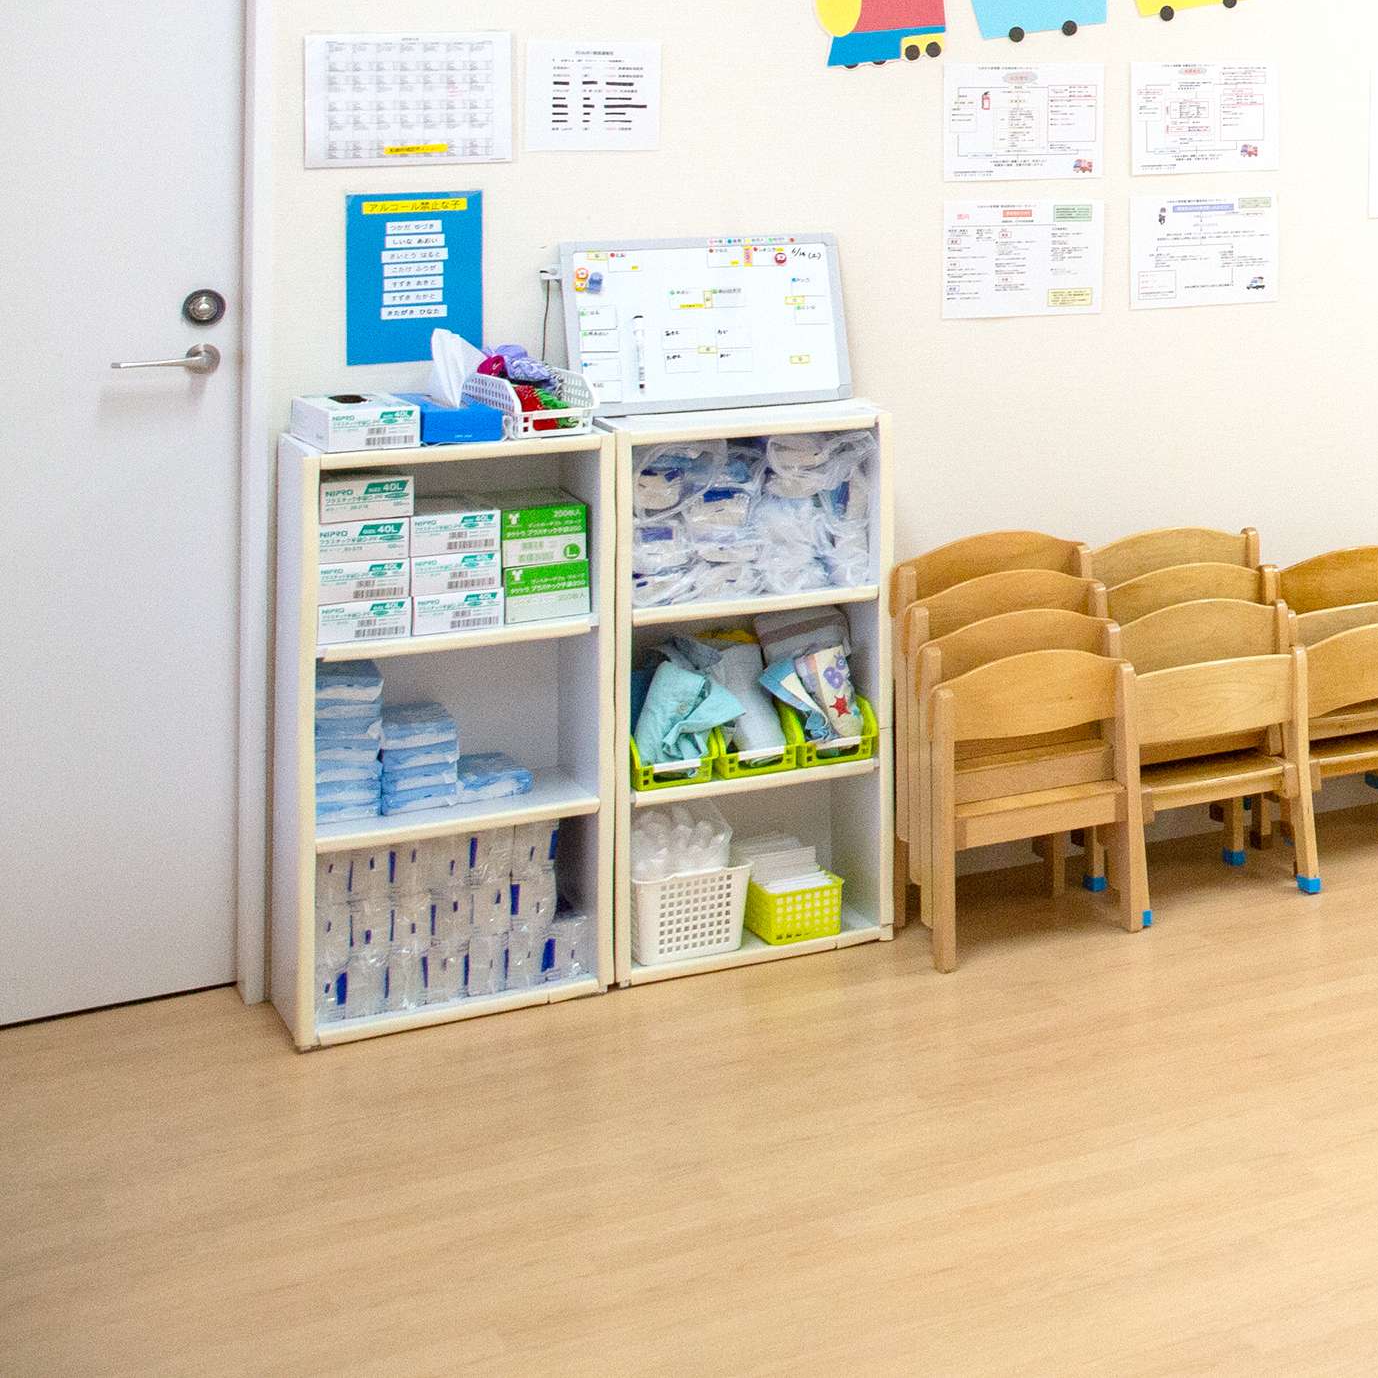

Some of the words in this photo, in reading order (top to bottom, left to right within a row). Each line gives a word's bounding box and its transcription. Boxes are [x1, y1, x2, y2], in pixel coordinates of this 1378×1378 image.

[369, 199, 461, 212] アルコール禁止な子
[325, 489, 353, 497] NIPRO
[567, 545, 578, 557] L
